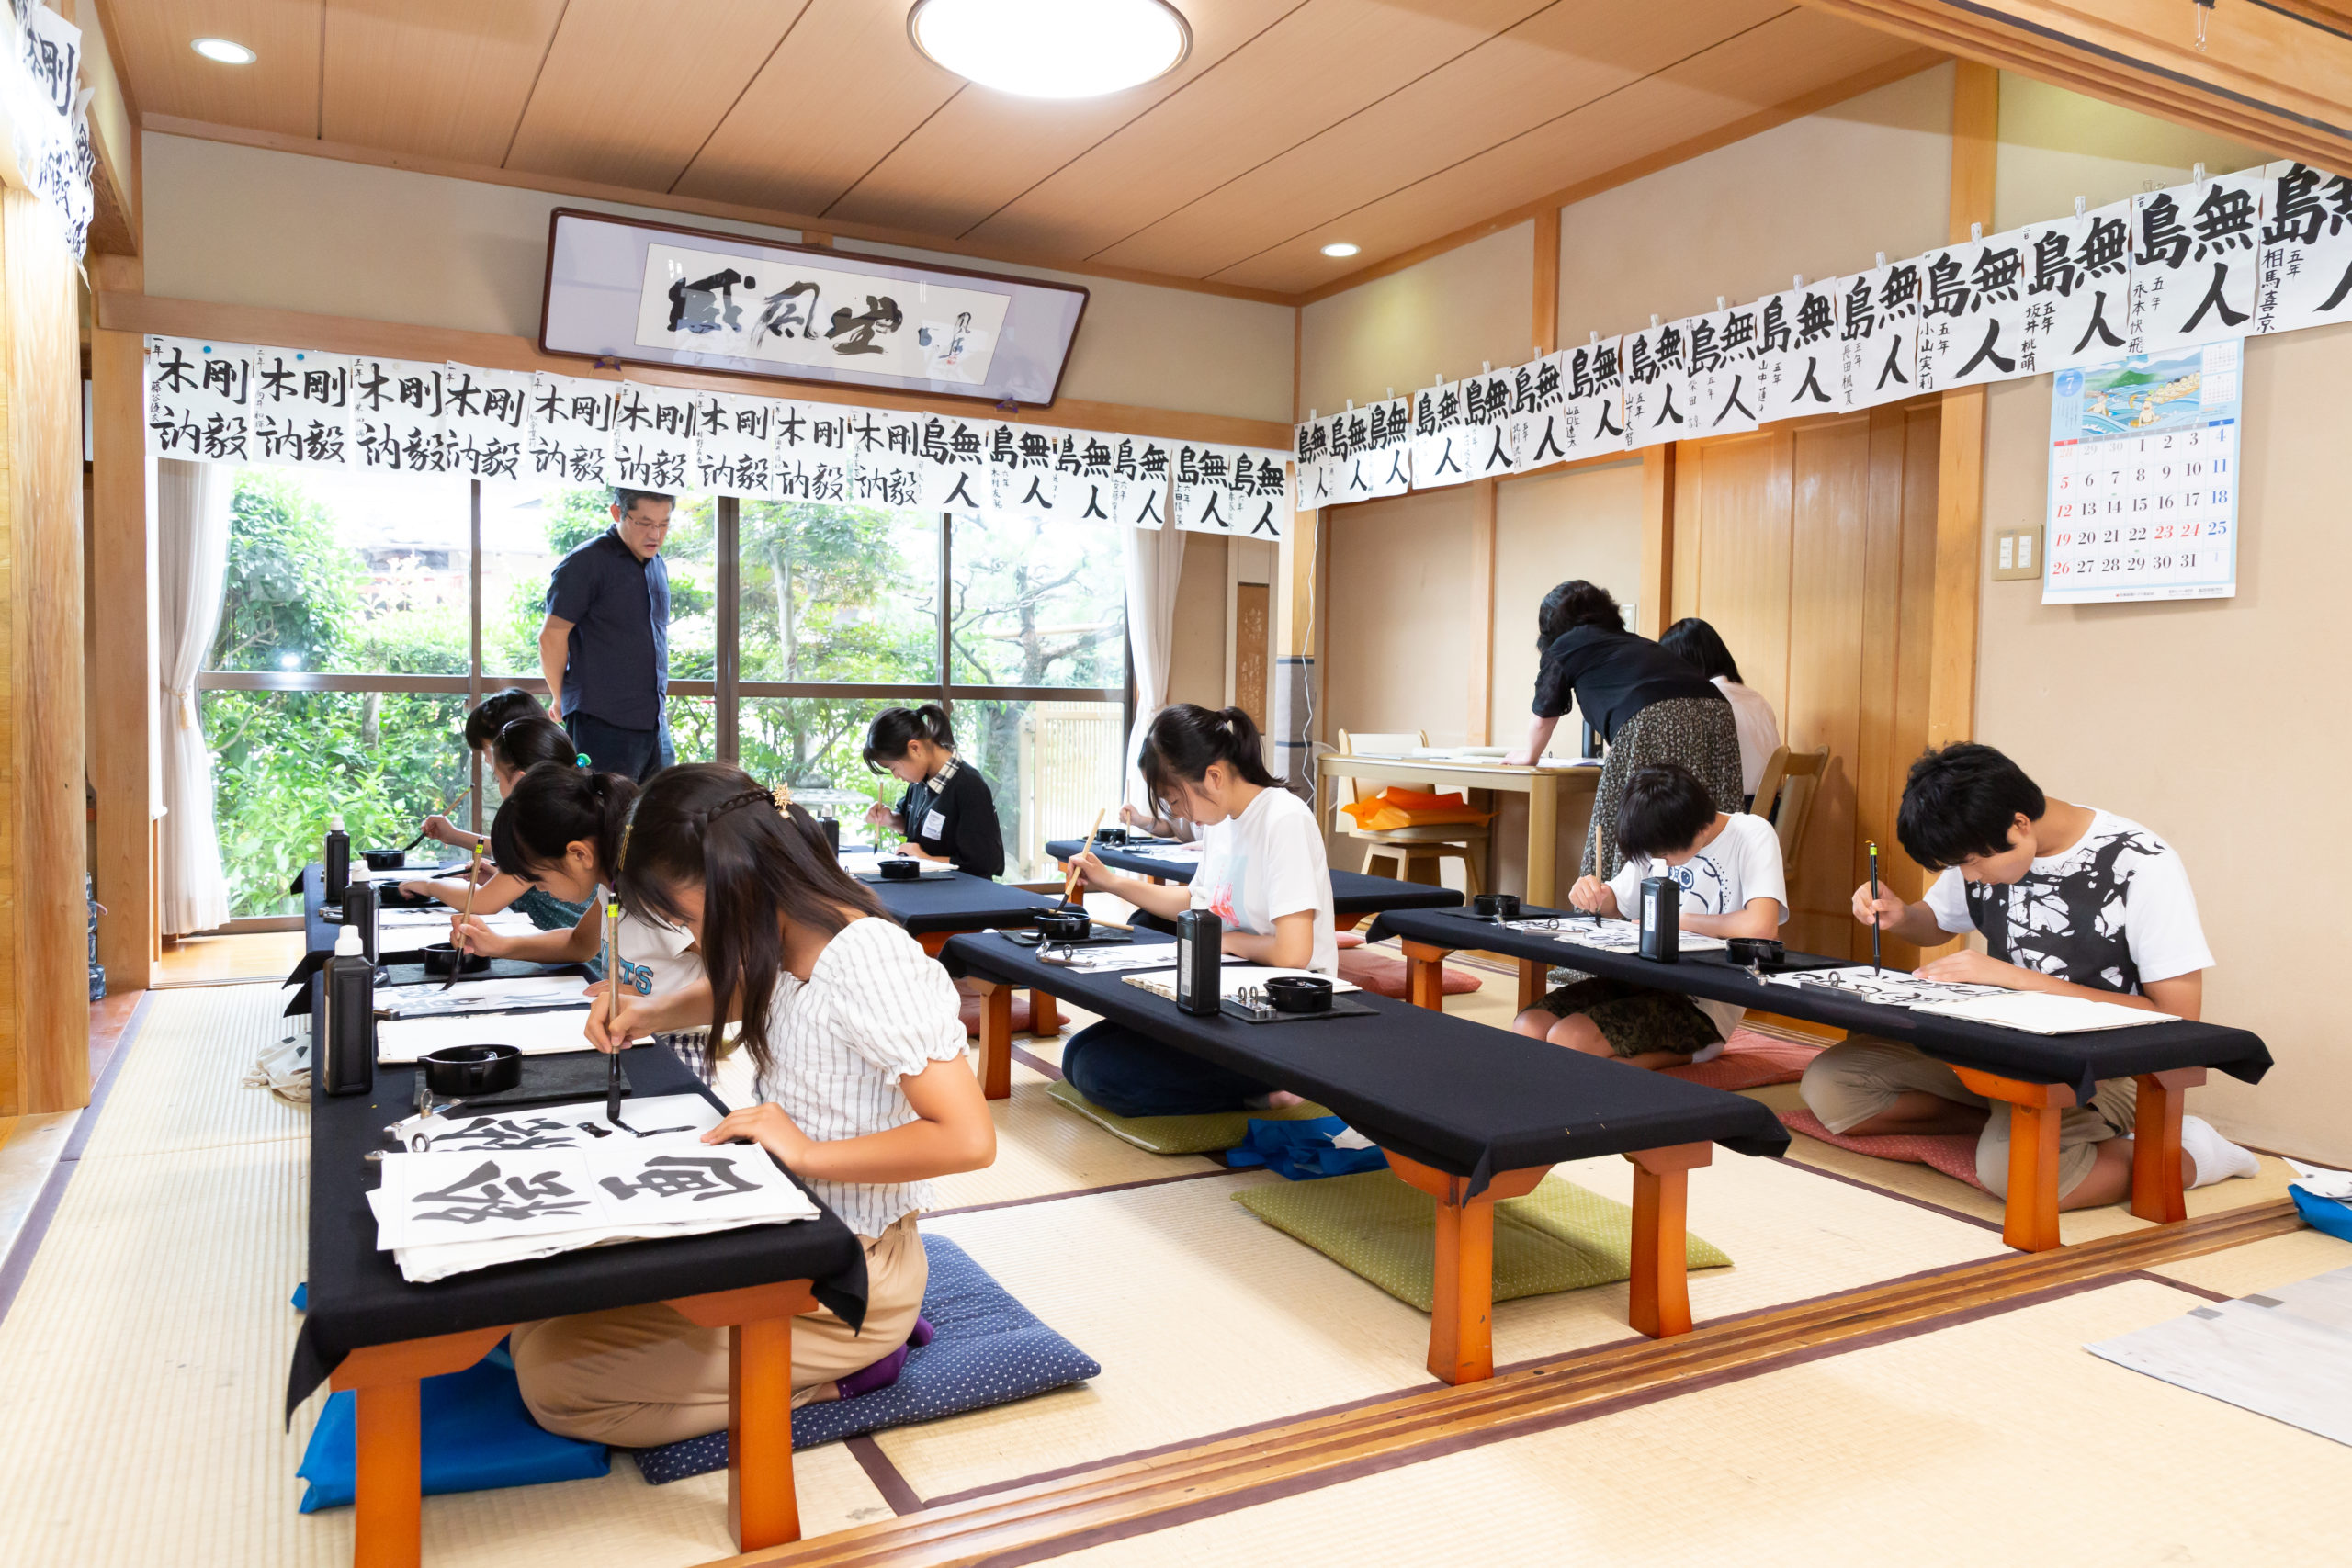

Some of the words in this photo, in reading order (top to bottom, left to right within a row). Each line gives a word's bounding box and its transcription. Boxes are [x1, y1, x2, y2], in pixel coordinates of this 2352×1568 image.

[2134, 193, 2192, 269] 島
[2261, 162, 2328, 245] 島
[1922, 252, 1971, 319] 島
[2027, 231, 2075, 297] 島
[2070, 217, 2127, 355] 無人
[2178, 183, 2256, 333] 無人
[2286, 249, 2304, 280] 五年
[1840, 276, 1875, 342] 島
[1952, 246, 2021, 379] 無人
[2041, 301, 2056, 335] 五年
[2150, 276, 2165, 311] 五年
[2257, 248, 2284, 333] 相馬喜京
[153, 337, 164, 359] 一年
[1687, 318, 1721, 378] 島
[1757, 295, 1792, 354] 島
[1791, 292, 1835, 404] 無人
[1875, 265, 1920, 392] 無人
[1937, 322, 1951, 356] 五年
[2021, 303, 2041, 372] 坂井桃萌
[1568, 348, 1594, 400] 島
[1629, 334, 1657, 385] 島
[1651, 325, 1684, 429] 無人
[1712, 311, 1757, 428] 無人
[1773, 362, 1781, 385] 五年
[1918, 321, 1935, 389] 小山実莉
[2065, 377, 2075, 390] 7
[1416, 391, 1434, 437] 島
[1464, 379, 1486, 426] 島
[1510, 367, 1536, 415] 島
[1533, 362, 1565, 461] 無人
[1574, 406, 1580, 426] 五年
[1593, 344, 1624, 441] 無人
[1634, 391, 1645, 419] 五年
[1707, 377, 1715, 400] 五年
[920, 417, 949, 465] 島
[989, 424, 1019, 469] 島
[1297, 425, 1312, 465] 島
[1329, 415, 1348, 463] 島
[1367, 404, 1387, 451] 島
[1385, 401, 1408, 485] 無人
[1434, 389, 1462, 477] 無人
[1484, 378, 1513, 471] 無人
[1624, 392, 1634, 446] 山下大智
[2084, 444, 2098, 456] 29
[2140, 439, 2145, 452] 1
[2164, 435, 2173, 449] 2
[2189, 432, 2199, 446] 3
[2216, 428, 2225, 442] 4
[943, 423, 983, 509] 無人
[1017, 431, 1053, 509] 無人
[1056, 434, 1082, 477] 島
[1080, 437, 1112, 520] 無人
[1114, 438, 1136, 481] 島
[1177, 446, 1199, 486] 島
[1229, 453, 1256, 498] 島
[1310, 423, 1329, 500] 無人
[1347, 414, 1368, 491] 無人
[2060, 476, 2069, 490] 5
[2086, 473, 2094, 487] 6
[2111, 471, 2120, 485] 7
[2136, 468, 2145, 481] 8
[2162, 466, 2171, 479] 9
[2186, 462, 2201, 477] 10
[2213, 459, 2227, 473] 11
[1136, 443, 1169, 524] 無人
[1197, 449, 1229, 528] 無人
[1250, 457, 1285, 536] 無人
[2056, 505, 2073, 518] 12
[2082, 502, 2097, 515] 13
[2107, 501, 2122, 513] 14
[2132, 498, 2147, 512] 15
[2158, 496, 2174, 509] 16
[2185, 493, 2200, 506] 17
[2211, 491, 2228, 504] 18
[2056, 534, 2071, 547] 19
[2078, 532, 2096, 545] 20
[2104, 530, 2119, 543] 21
[2129, 527, 2146, 541] 22
[2154, 525, 2174, 539] 23
[2181, 523, 2200, 537] 24
[2208, 521, 2227, 536] 25
[2052, 561, 2070, 575] 26
[2077, 560, 2095, 573] 27
[2102, 558, 2120, 572] 28
[2127, 557, 2145, 570] 29
[2153, 555, 2172, 569] 30
[2181, 553, 2197, 568] 31
[412, 1155, 764, 1224] 絵画
